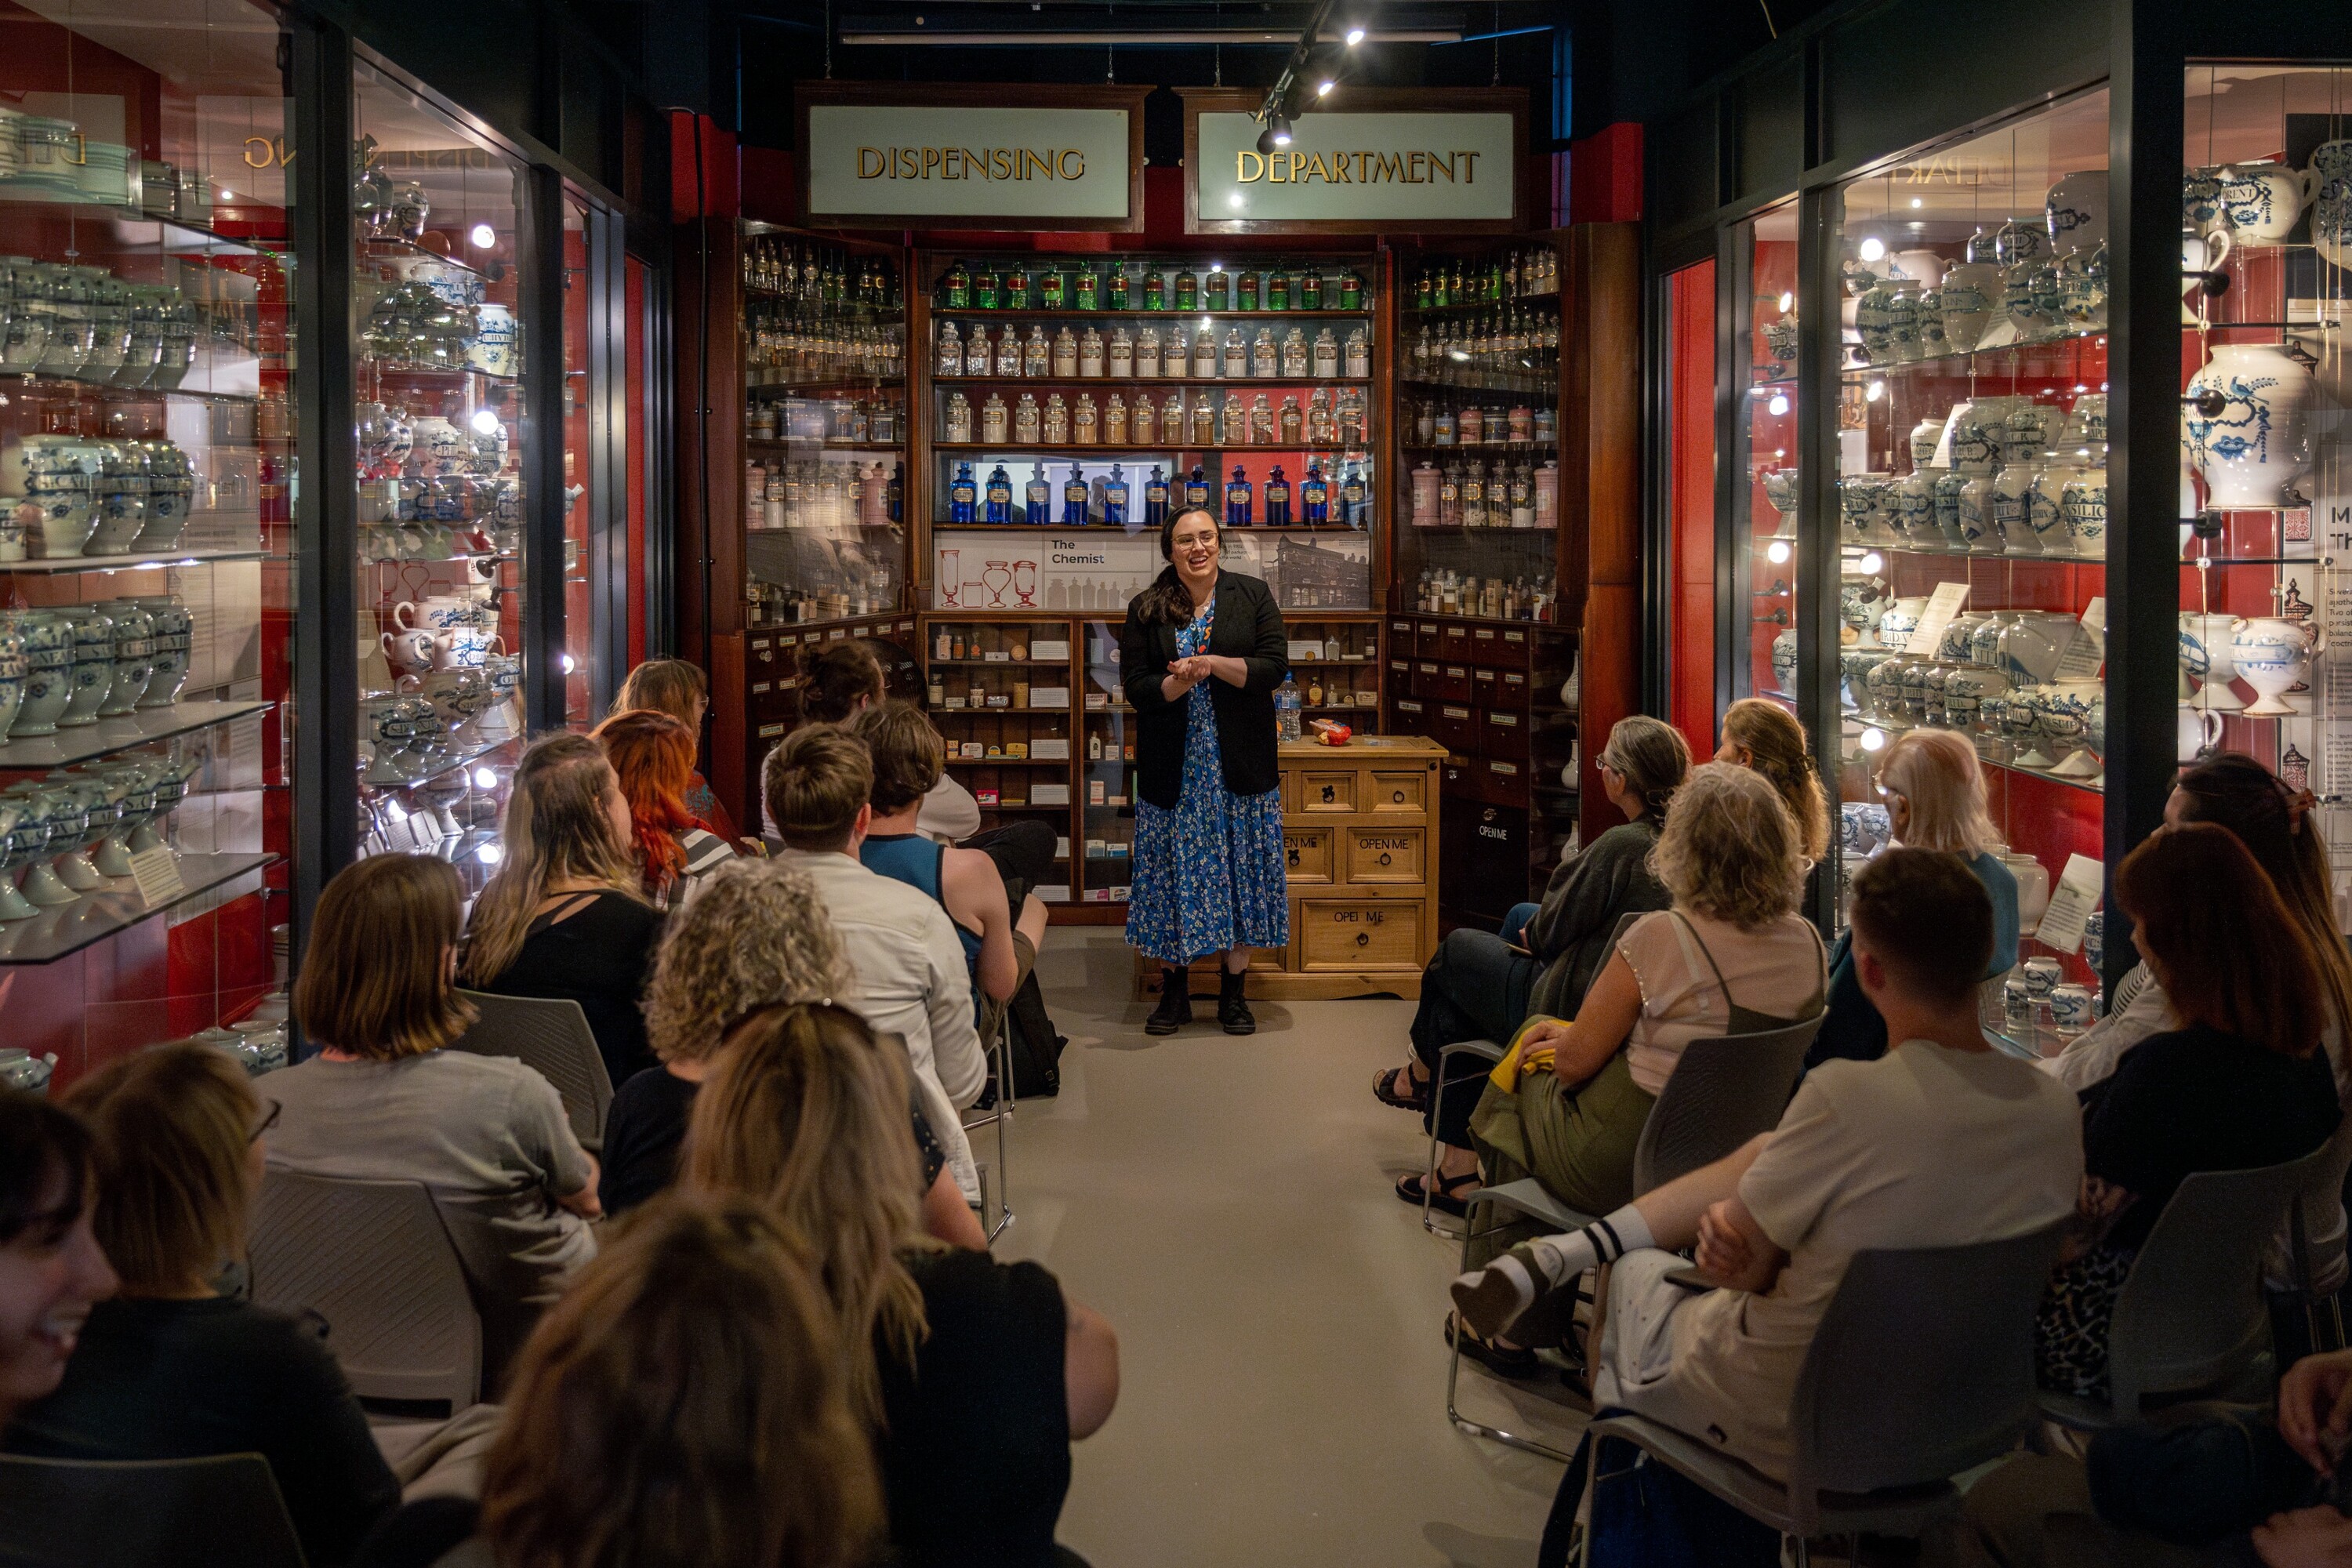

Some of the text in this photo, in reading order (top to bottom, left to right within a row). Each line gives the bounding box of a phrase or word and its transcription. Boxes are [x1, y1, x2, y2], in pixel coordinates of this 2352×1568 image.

[856, 146, 1086, 181] DISPENSING
[1236, 150, 1480, 184] DEPARTMENT
[2332, 506, 2352, 524] M
[1052, 539, 1075, 549] The
[1052, 554, 1105, 564] Chemist
[1479, 826, 1507, 840] OPEN ME
[1283, 837, 1317, 848] EN ME
[1359, 839, 1409, 849] OPEN ME
[1367, 912, 1384, 922] ME
